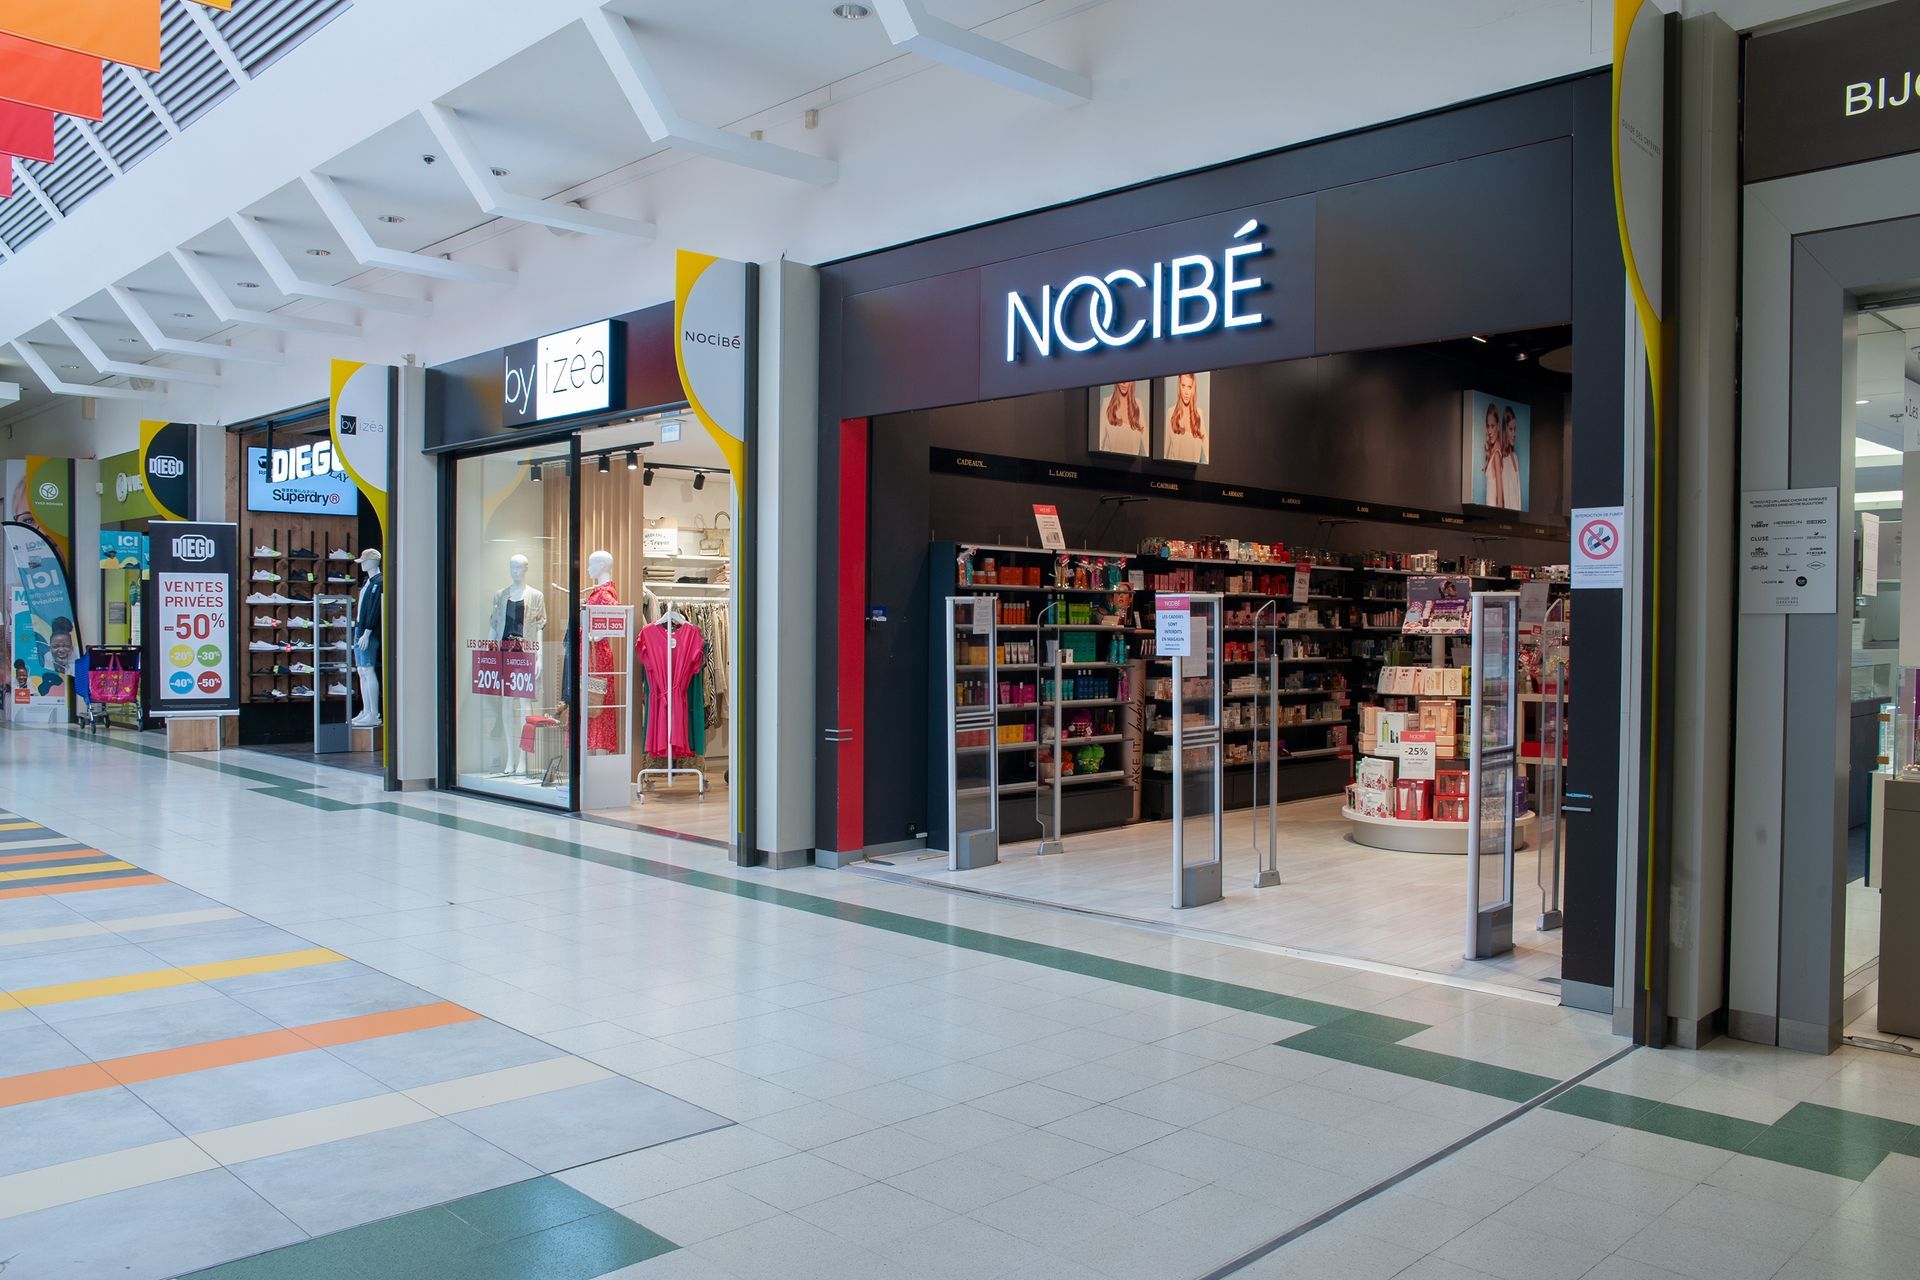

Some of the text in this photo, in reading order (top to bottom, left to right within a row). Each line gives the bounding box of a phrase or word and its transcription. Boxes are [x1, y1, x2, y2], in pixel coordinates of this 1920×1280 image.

[1845, 71, 1920, 116] BIJ
[1006, 219, 1263, 362] NOCIBÉ
[504, 336, 605, 415] by izéa
[341, 417, 384, 433] by izéa
[149, 457, 184, 476] DIEGO
[1056, 470, 1078, 479] LACOSTE
[118, 536, 139, 547] ICI
[172, 538, 215, 558] DIEGO
[164, 581, 224, 593] VENTES
[165, 594, 224, 608] PRIVÉES
[164, 612, 225, 640] -50%
[466, 639, 477, 649] LES
[197, 651, 221, 661] -30%
[481, 657, 497, 665] ARTICLES
[170, 677, 221, 688] -40% -50%
[473, 669, 534, 693] -20% -30%
[1404, 747, 1429, 756] -25%
[1131, 759, 1141, 792] FAKE
